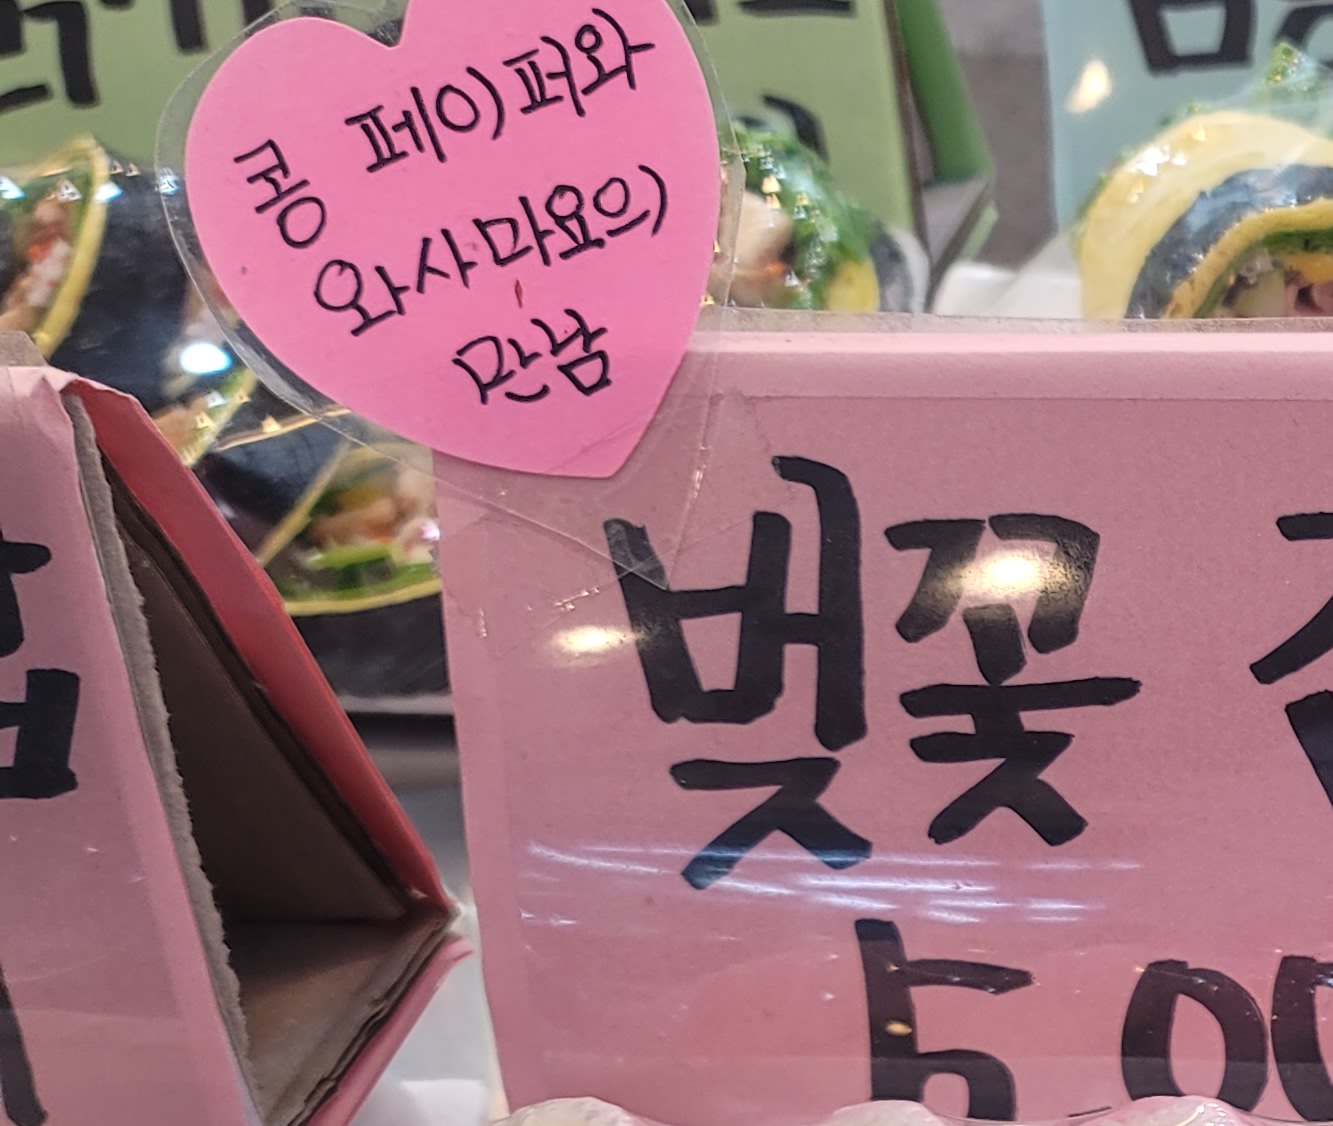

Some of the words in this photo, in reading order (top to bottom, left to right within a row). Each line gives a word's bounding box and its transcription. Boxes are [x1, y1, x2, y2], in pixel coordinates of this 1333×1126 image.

[234, 139, 327, 249] 콩
[345, 8, 655, 173] 페이퍼와
[313, 164, 668, 337] 와사마요의
[452, 308, 612, 405] 만남
[603, 456, 1142, 890] 벚꽃
